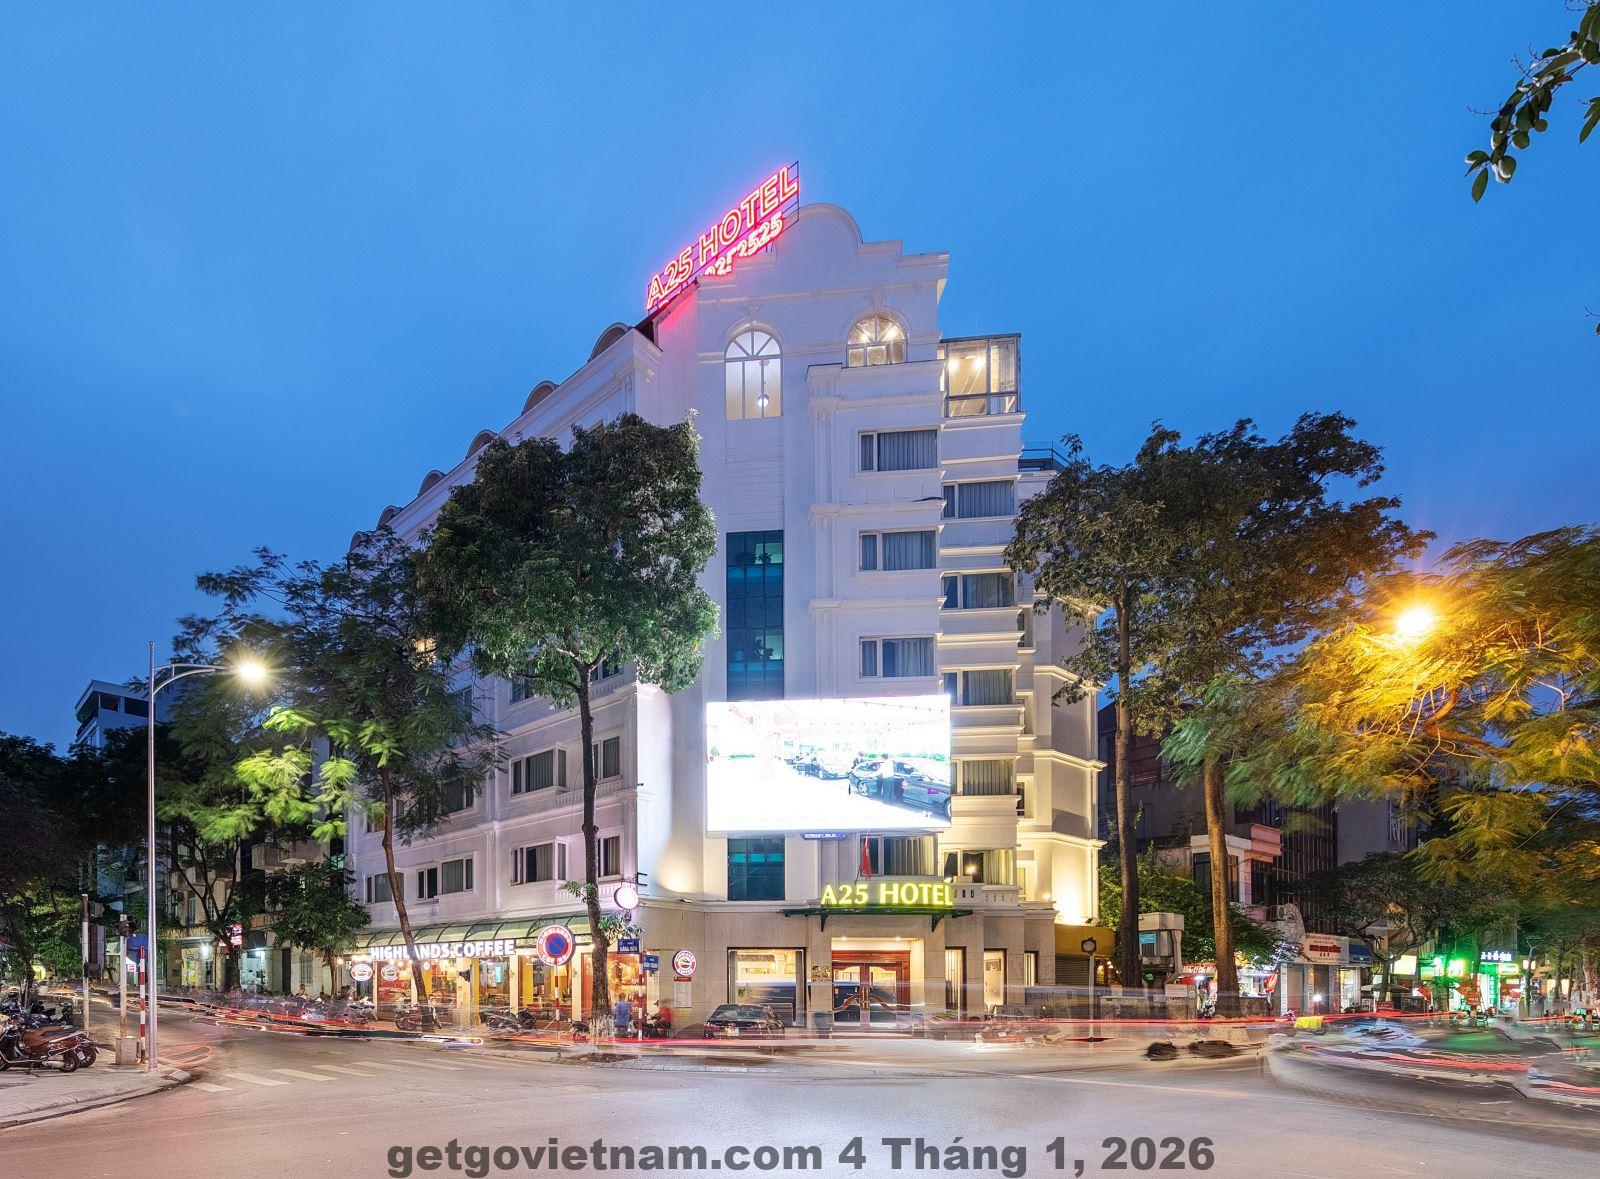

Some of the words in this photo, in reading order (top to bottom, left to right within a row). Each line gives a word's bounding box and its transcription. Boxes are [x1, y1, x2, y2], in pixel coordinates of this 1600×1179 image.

[647, 246, 694, 309] A25
[699, 166, 798, 266] HOTEL
[821, 883, 869, 905] A25
[879, 882, 953, 906] HOTEL
[455, 939, 516, 957] COFFEE
